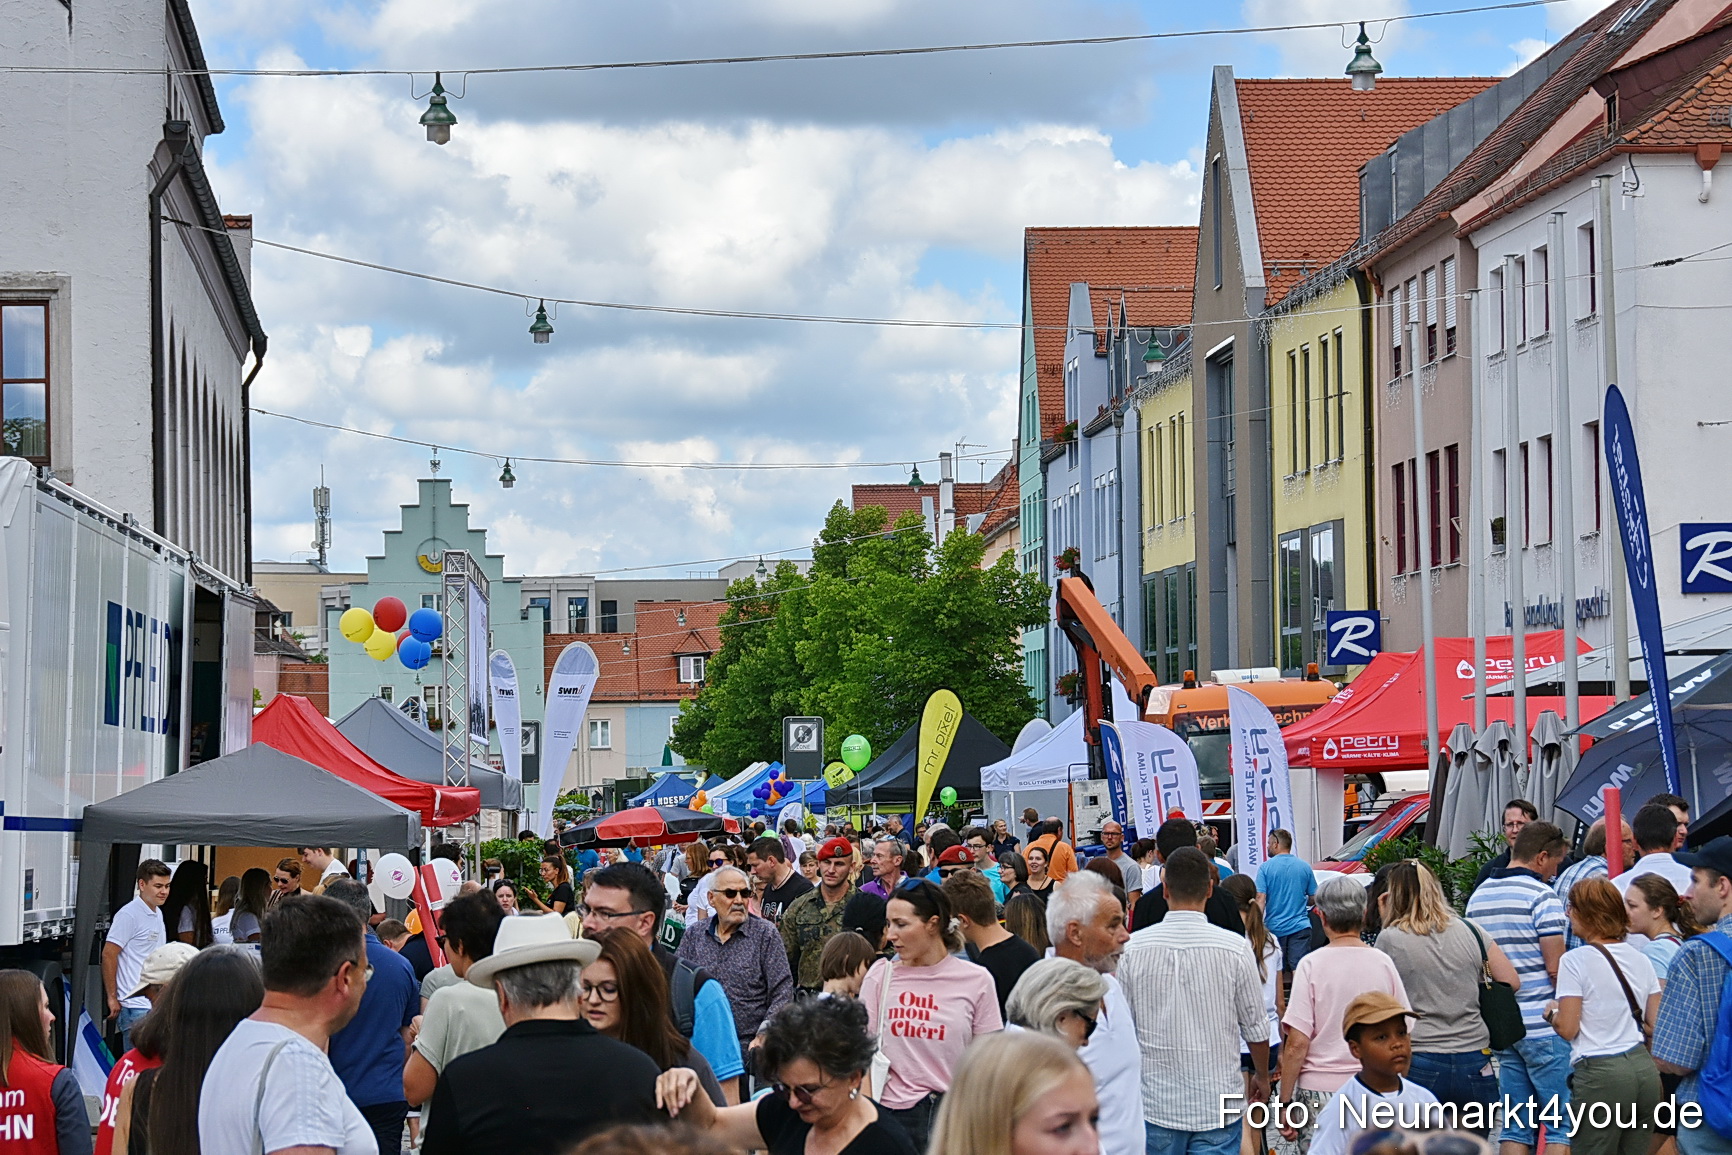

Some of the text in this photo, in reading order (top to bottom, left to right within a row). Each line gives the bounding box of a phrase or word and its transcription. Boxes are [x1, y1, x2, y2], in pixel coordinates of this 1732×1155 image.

[557, 686, 579, 695] swn
[1340, 736, 1399, 750] Petry
[888, 1007, 931, 1021] mon
[890, 1020, 946, 1041] Chéri
